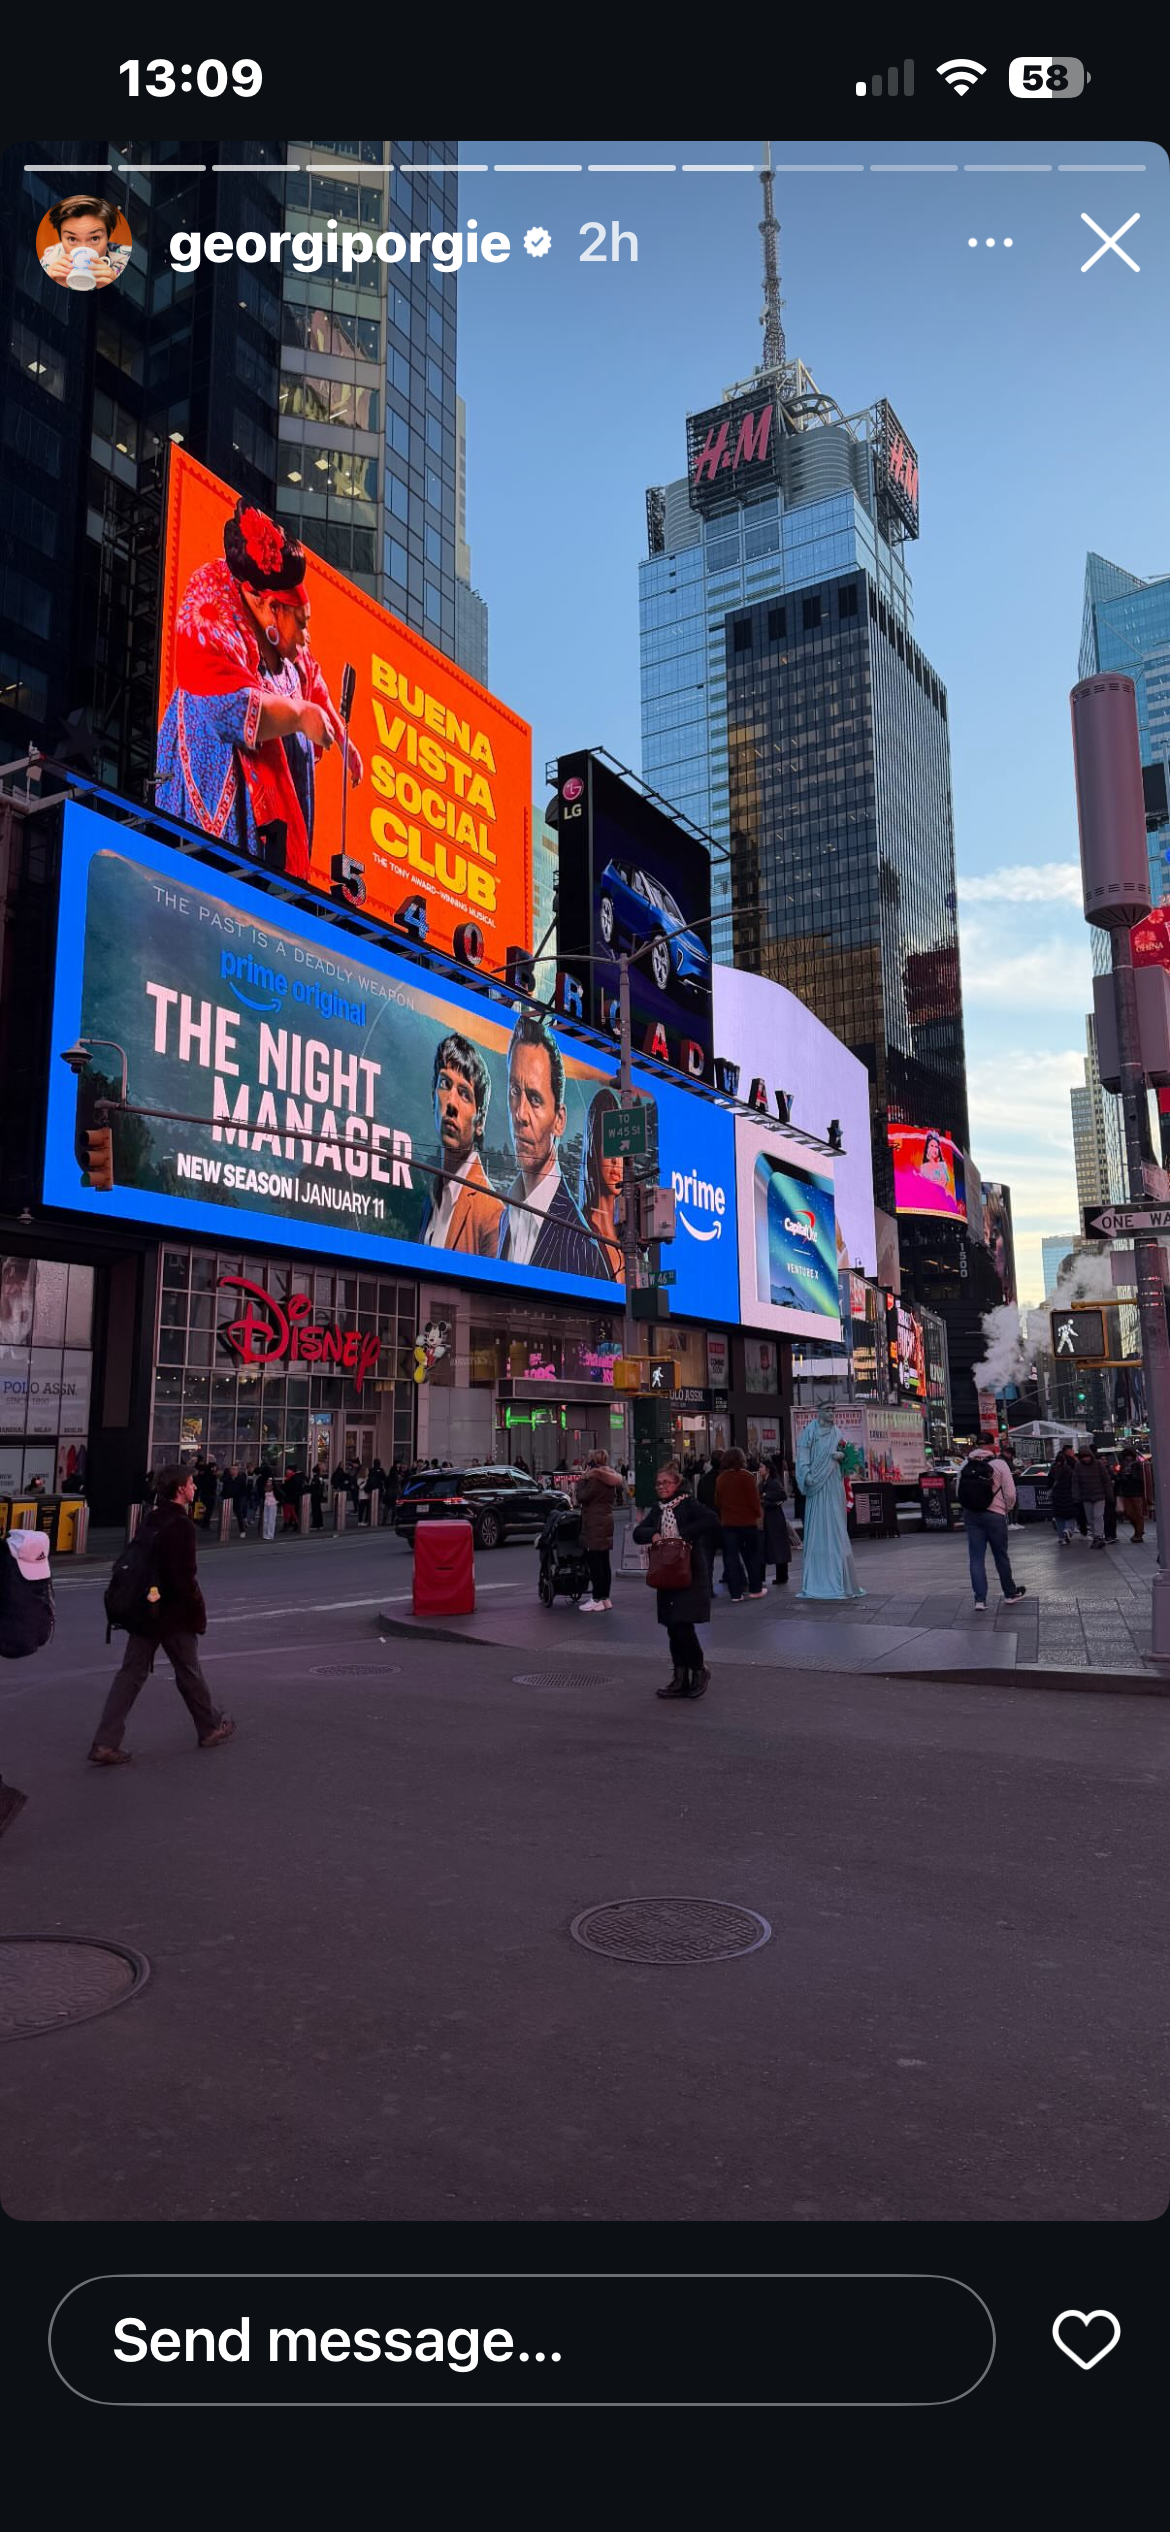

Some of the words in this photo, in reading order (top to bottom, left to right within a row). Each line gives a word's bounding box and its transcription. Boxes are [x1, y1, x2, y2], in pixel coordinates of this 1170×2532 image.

[694, 404, 773, 484] H&M
[371, 653, 497, 774] BUENA
[371, 698, 497, 821] VISTA
[370, 755, 497, 865] SOCIAL
[563, 804, 582, 820] LG
[370, 807, 497, 913] CLUB
[372, 852, 388, 869] THE
[389, 862, 410, 879] TONY
[411, 875, 468, 912] AWARD-WINNING
[468, 907, 496, 928] MUSICAL
[153, 886, 190, 915] THE
[199, 906, 246, 938] PAST
[252, 929, 269, 948] IS
[275, 941, 287, 957] A
[294, 948, 353, 984] DEADLY
[358, 975, 415, 1010] WEAPON
[221, 949, 288, 996] prime
[291, 975, 366, 1027] original
[145, 981, 240, 1077] THE
[258, 1020, 382, 1118] NIGHT
[212, 1077, 414, 1190] MANAGER
[608, 1129, 616, 1138] W
[617, 1127, 630, 1138] 45
[618, 1114, 630, 1123] TO
[176, 1152, 222, 1184] NEW
[223, 1163, 294, 1200] SEASON
[301, 1182, 371, 1216] JANUARY
[372, 1198, 385, 1219] 11
[671, 1168, 725, 1215] prime
[1101, 1214, 1134, 1229] ONE
[657, 1272, 668, 1285] 46
[3, 1381, 39, 1394] POLO
[43, 1382, 78, 1397] ASSN.
